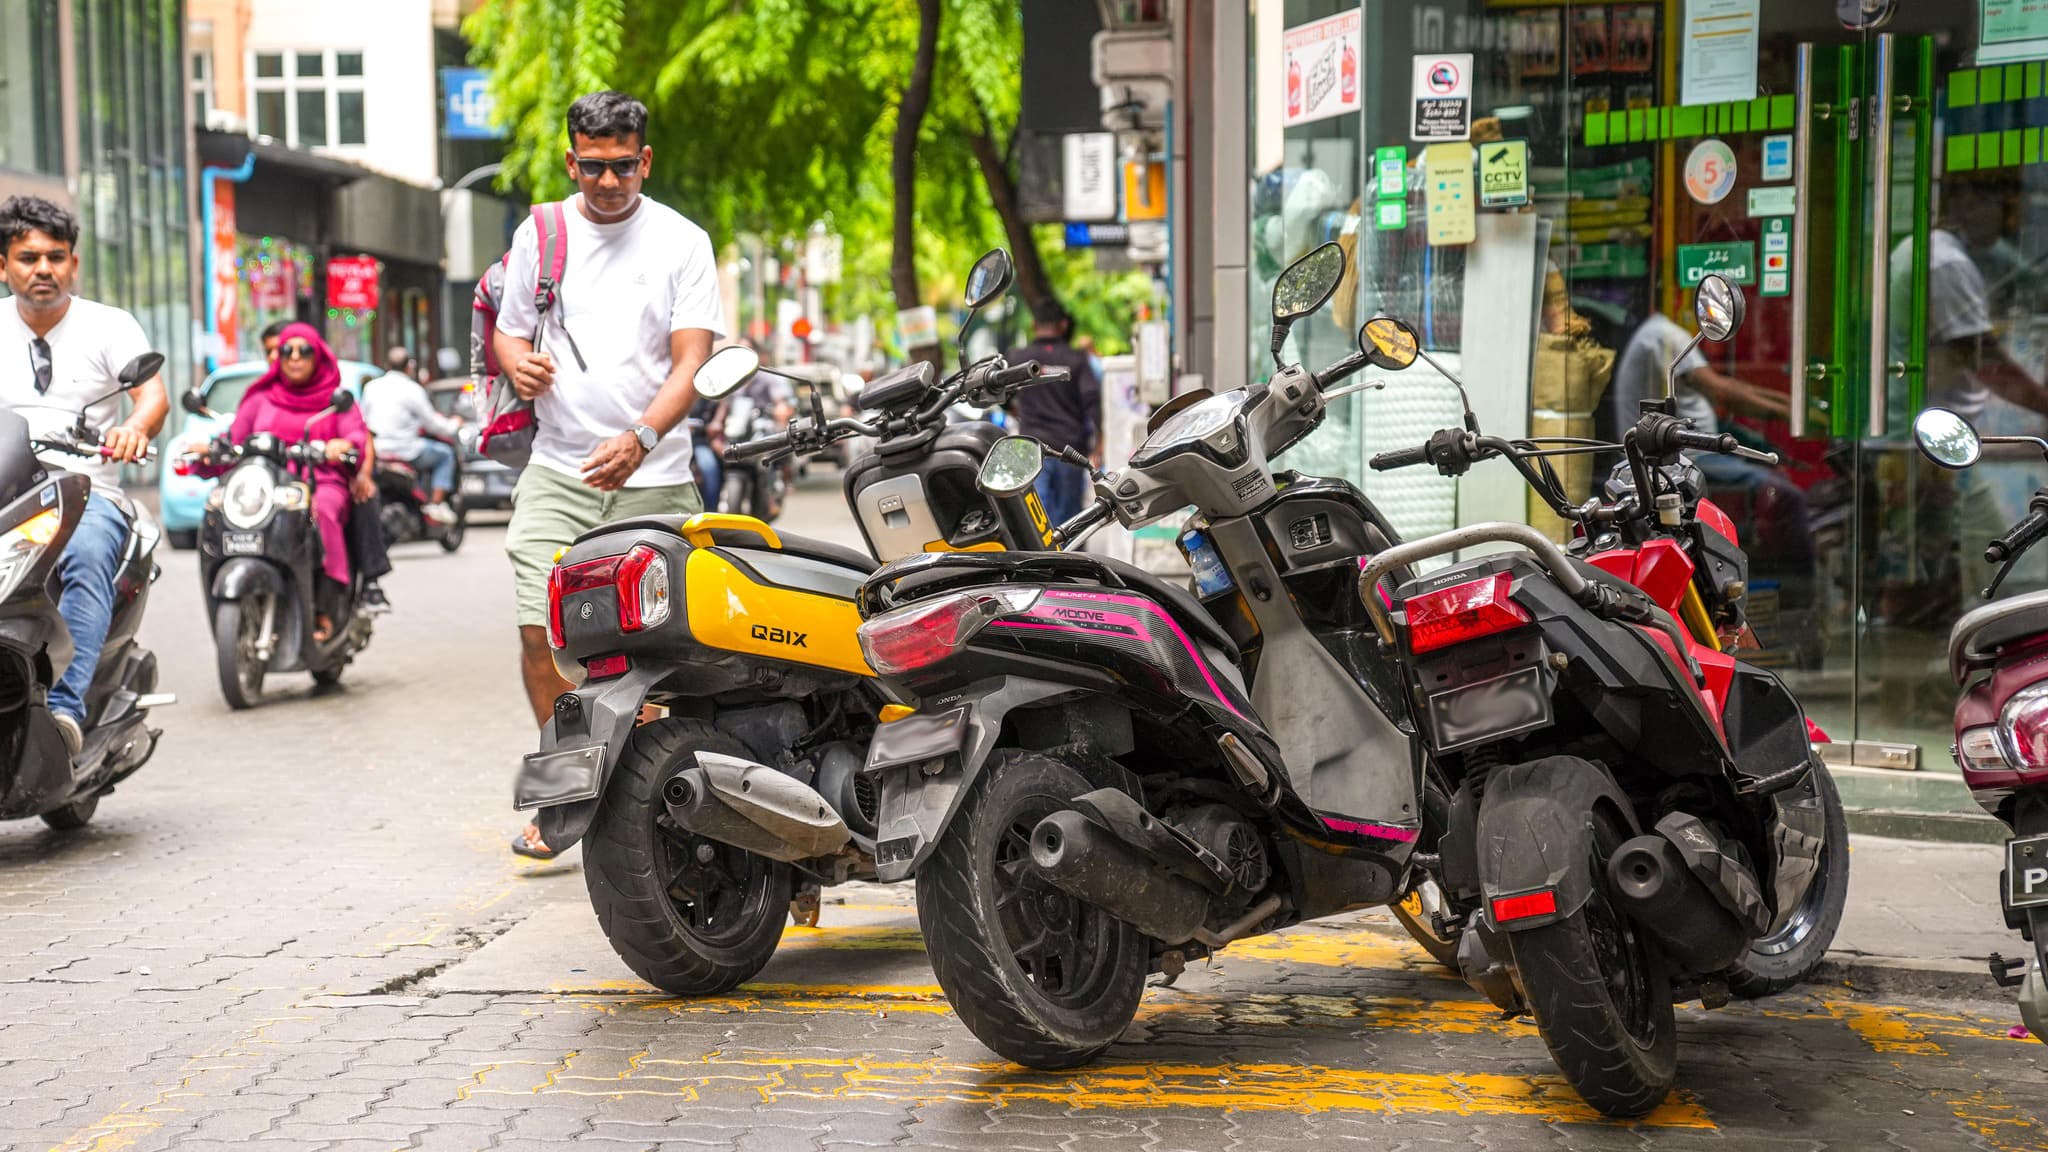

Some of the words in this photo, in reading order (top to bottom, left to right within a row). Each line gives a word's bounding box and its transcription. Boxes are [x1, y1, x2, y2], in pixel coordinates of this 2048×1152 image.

[1485, 171, 1522, 183] CCTV
[1704, 160, 1718, 184] 5
[1433, 573, 1467, 585] HONDA
[1053, 608, 1105, 621] MOOVE
[751, 624, 808, 648] QBIX
[936, 694, 962, 706] ONDA
